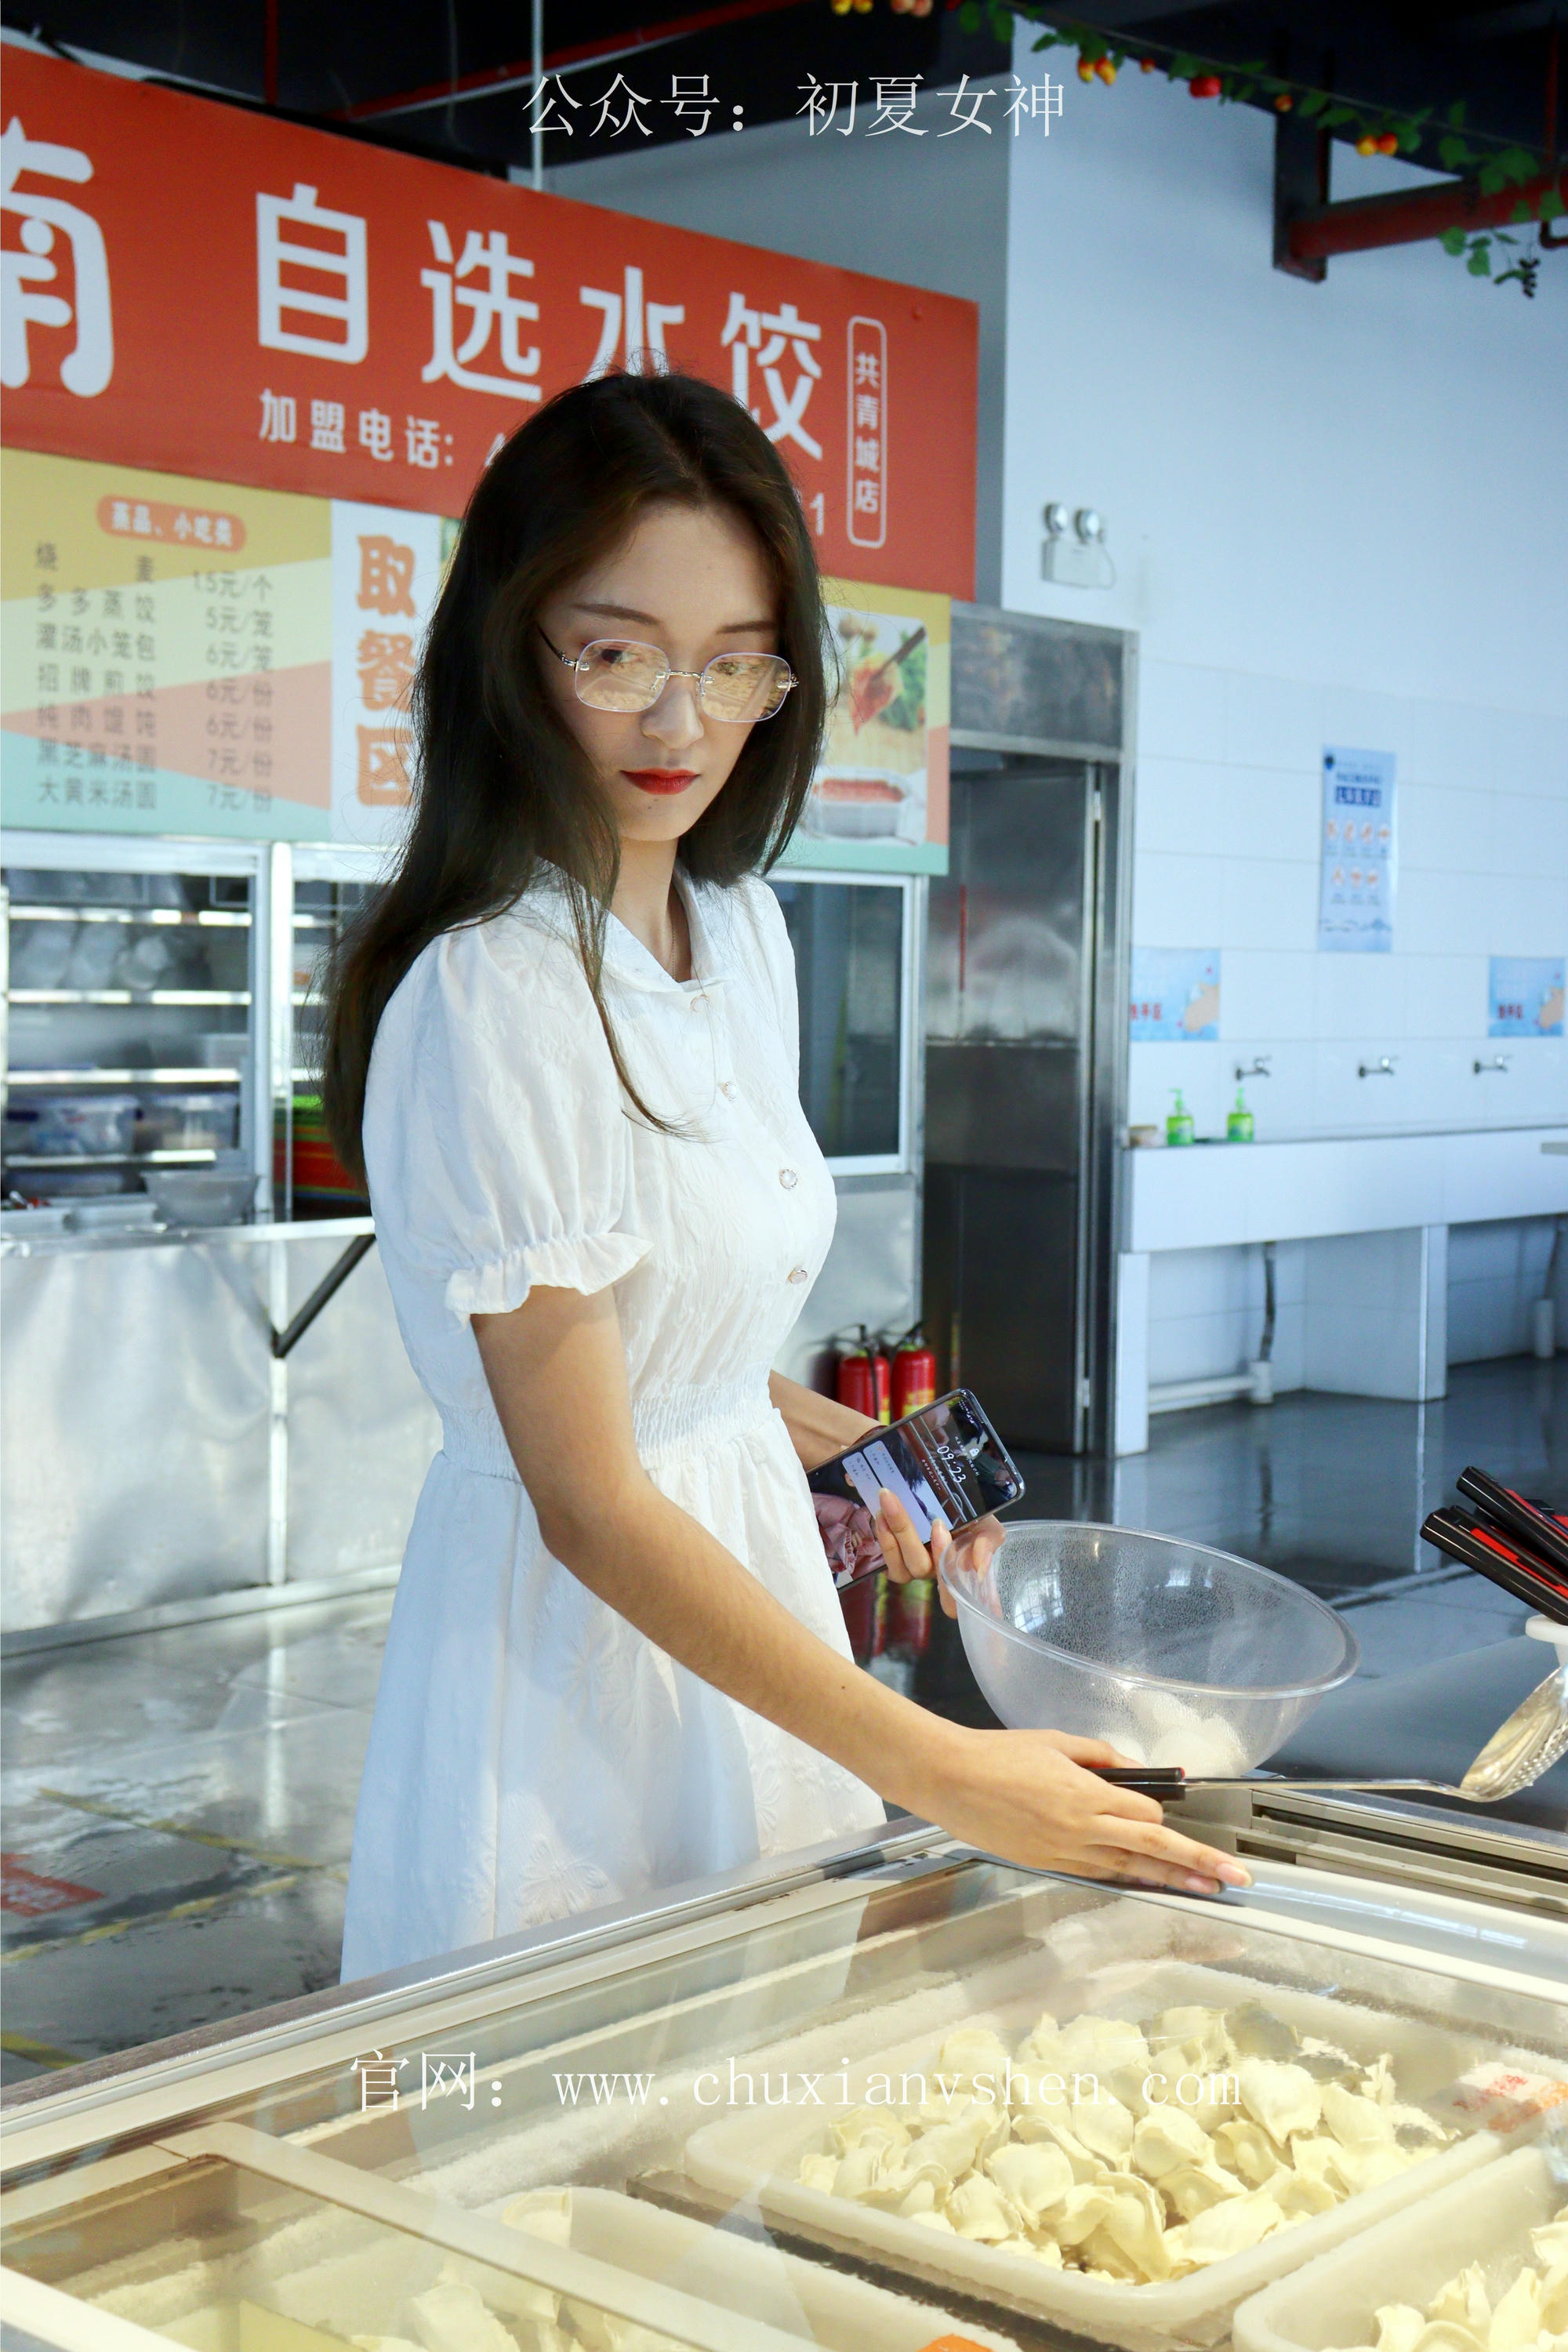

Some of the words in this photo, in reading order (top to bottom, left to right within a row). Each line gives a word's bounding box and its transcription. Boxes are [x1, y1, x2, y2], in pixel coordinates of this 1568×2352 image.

[256, 183, 822, 460] 自选水饺
[855, 353, 880, 514] 共青城店
[36, 622, 157, 662] 灌汤小笼包
[356, 535, 416, 806] 取餐区
[937, 1445, 967, 1484] 09:23
